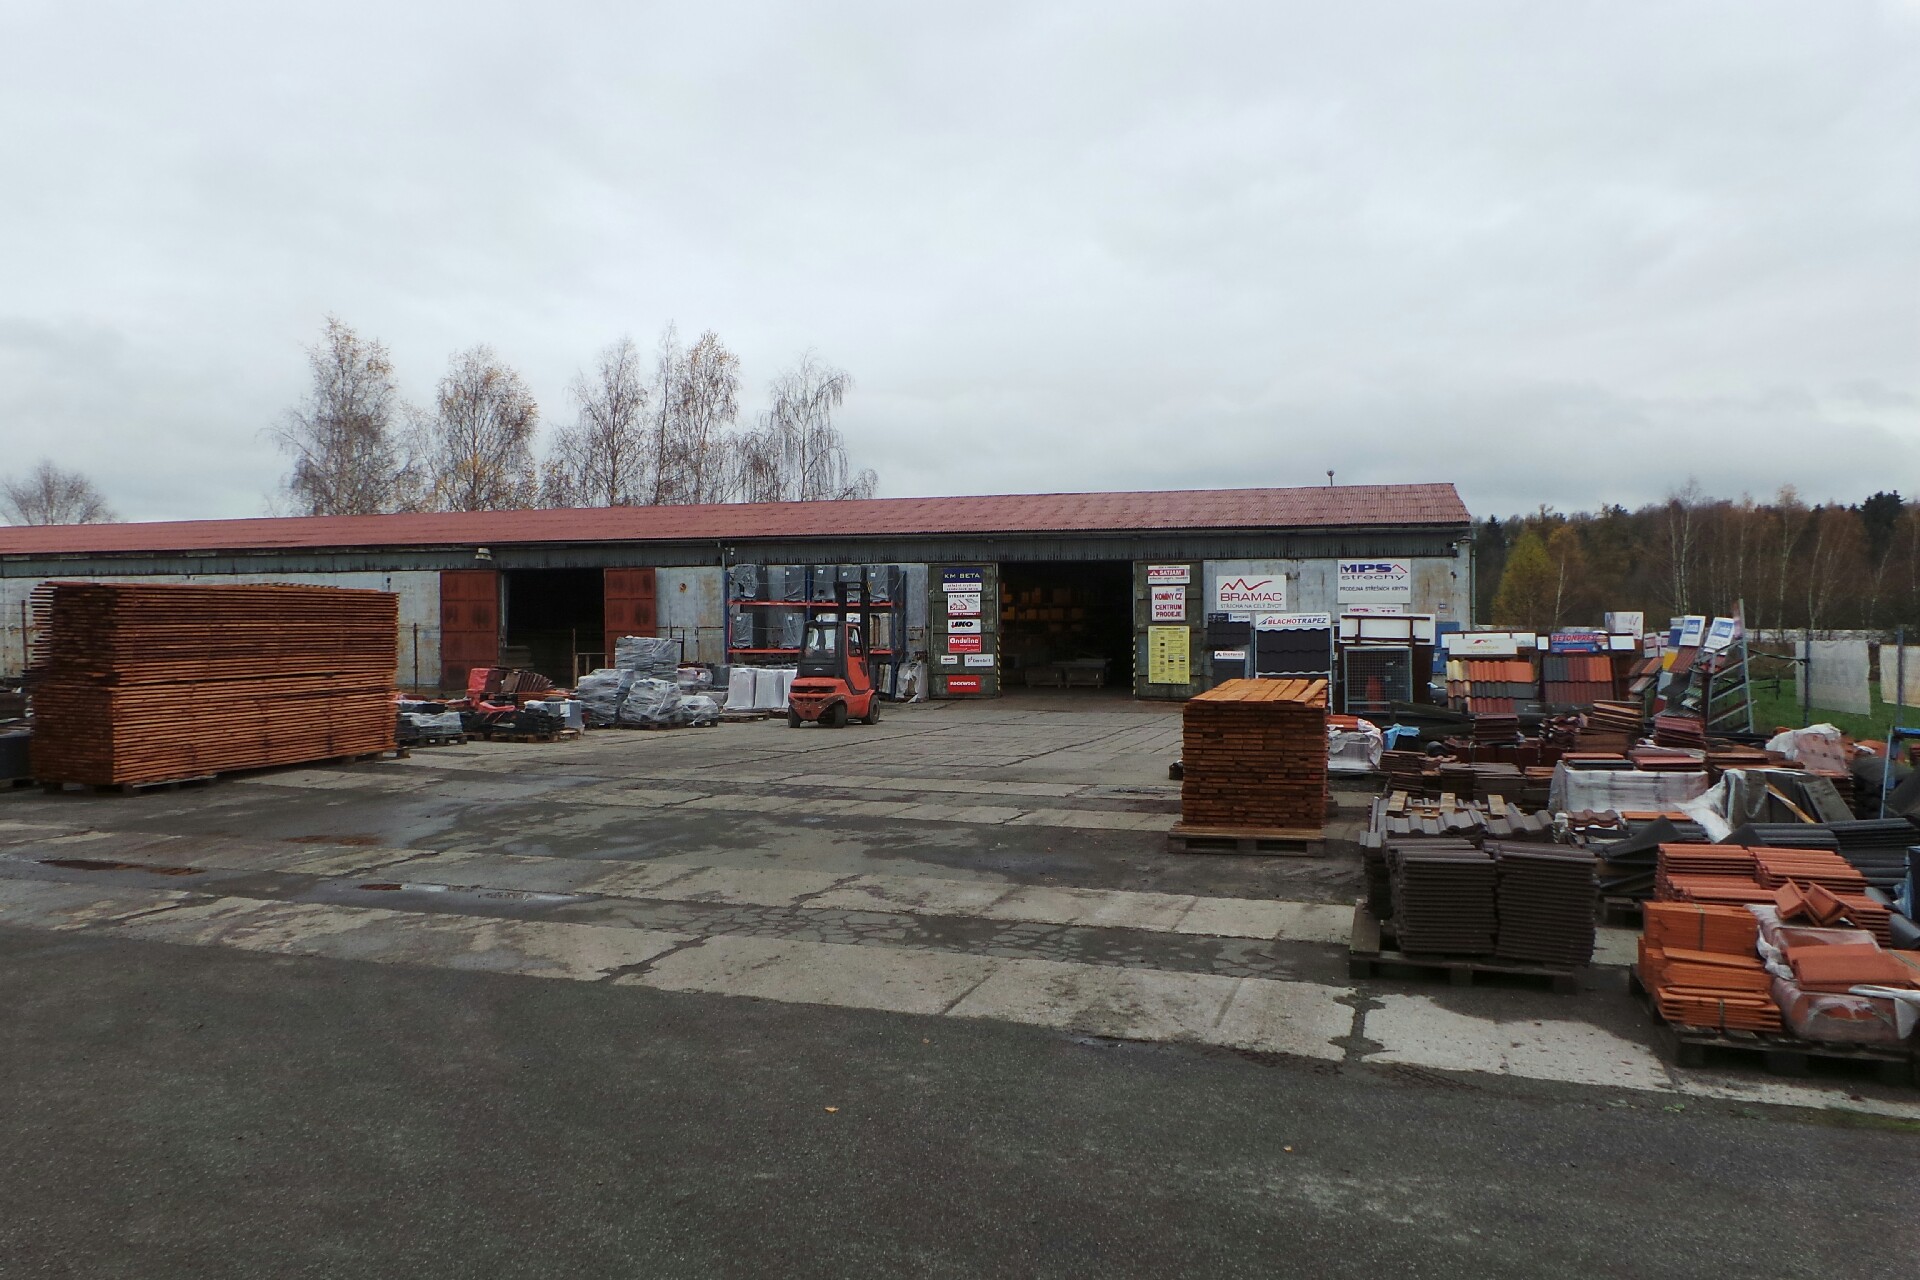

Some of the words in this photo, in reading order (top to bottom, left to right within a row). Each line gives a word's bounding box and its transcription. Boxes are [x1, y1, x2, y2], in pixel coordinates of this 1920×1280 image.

[1340, 563, 1392, 573] MPS
[1220, 592, 1282, 602] BRAMAC
[1267, 617, 1327, 626] BLACHOTRAPEZ
